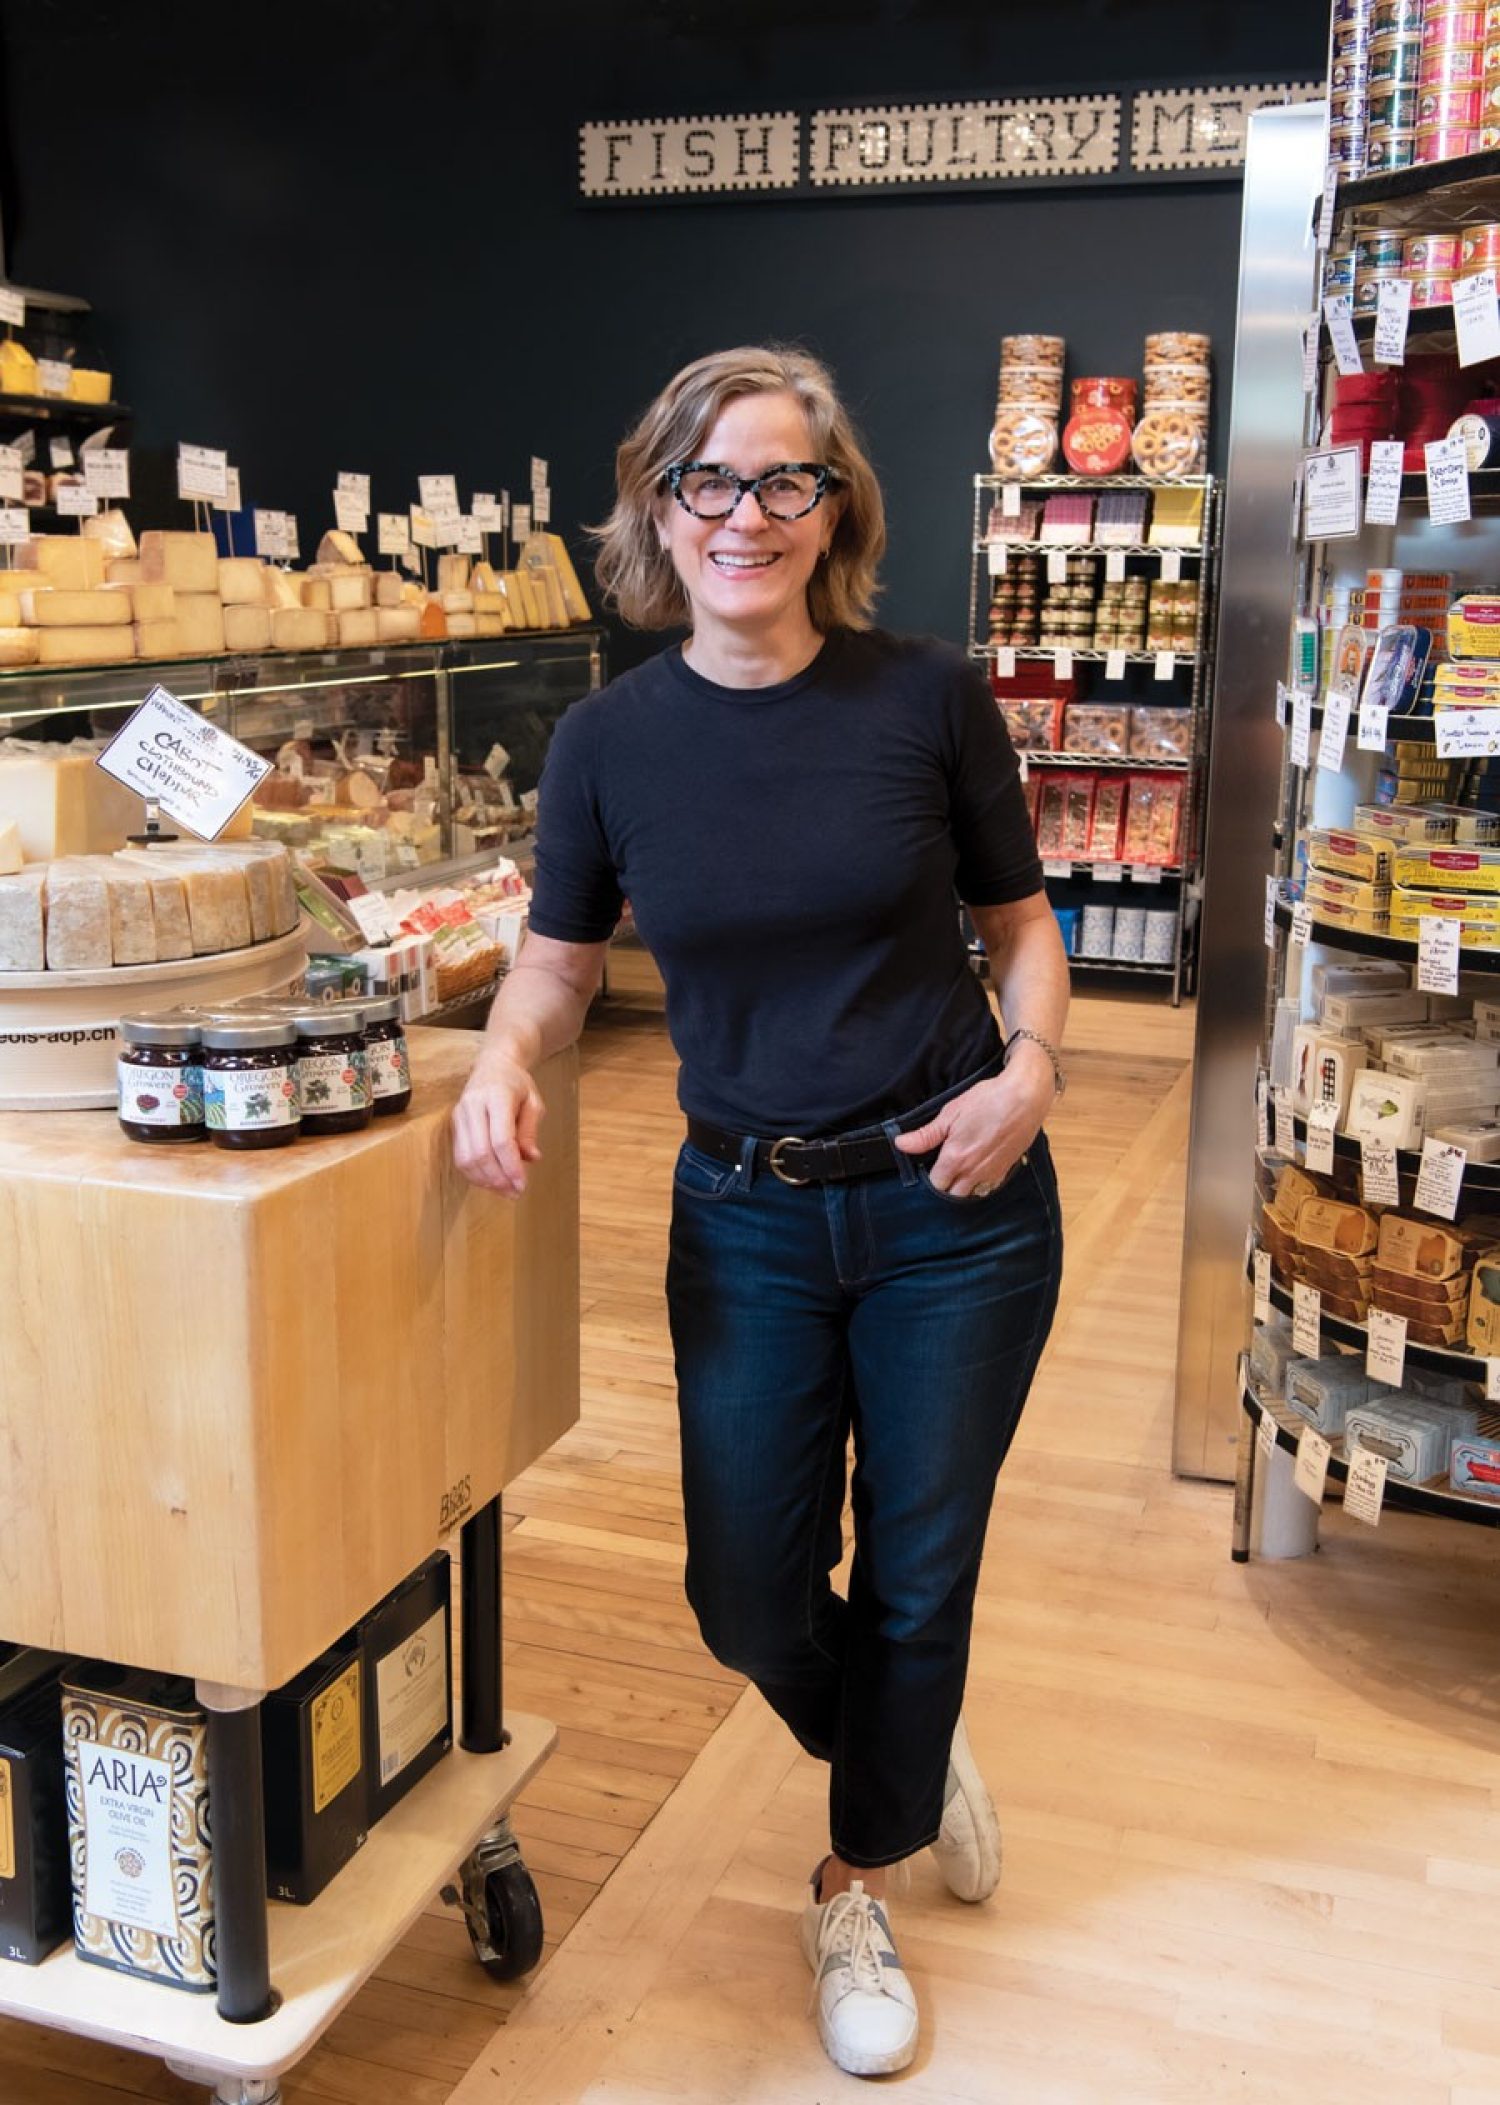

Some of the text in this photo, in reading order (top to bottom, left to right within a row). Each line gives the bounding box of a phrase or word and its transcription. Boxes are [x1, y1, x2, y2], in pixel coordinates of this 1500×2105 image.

[605, 126, 773, 182] FISH
[825, 109, 1106, 171] POULTRY
[154, 731, 223, 774] CABOT
[229, 1069, 282, 1084] OREGON
[88, 1756, 168, 1803] ARIA
